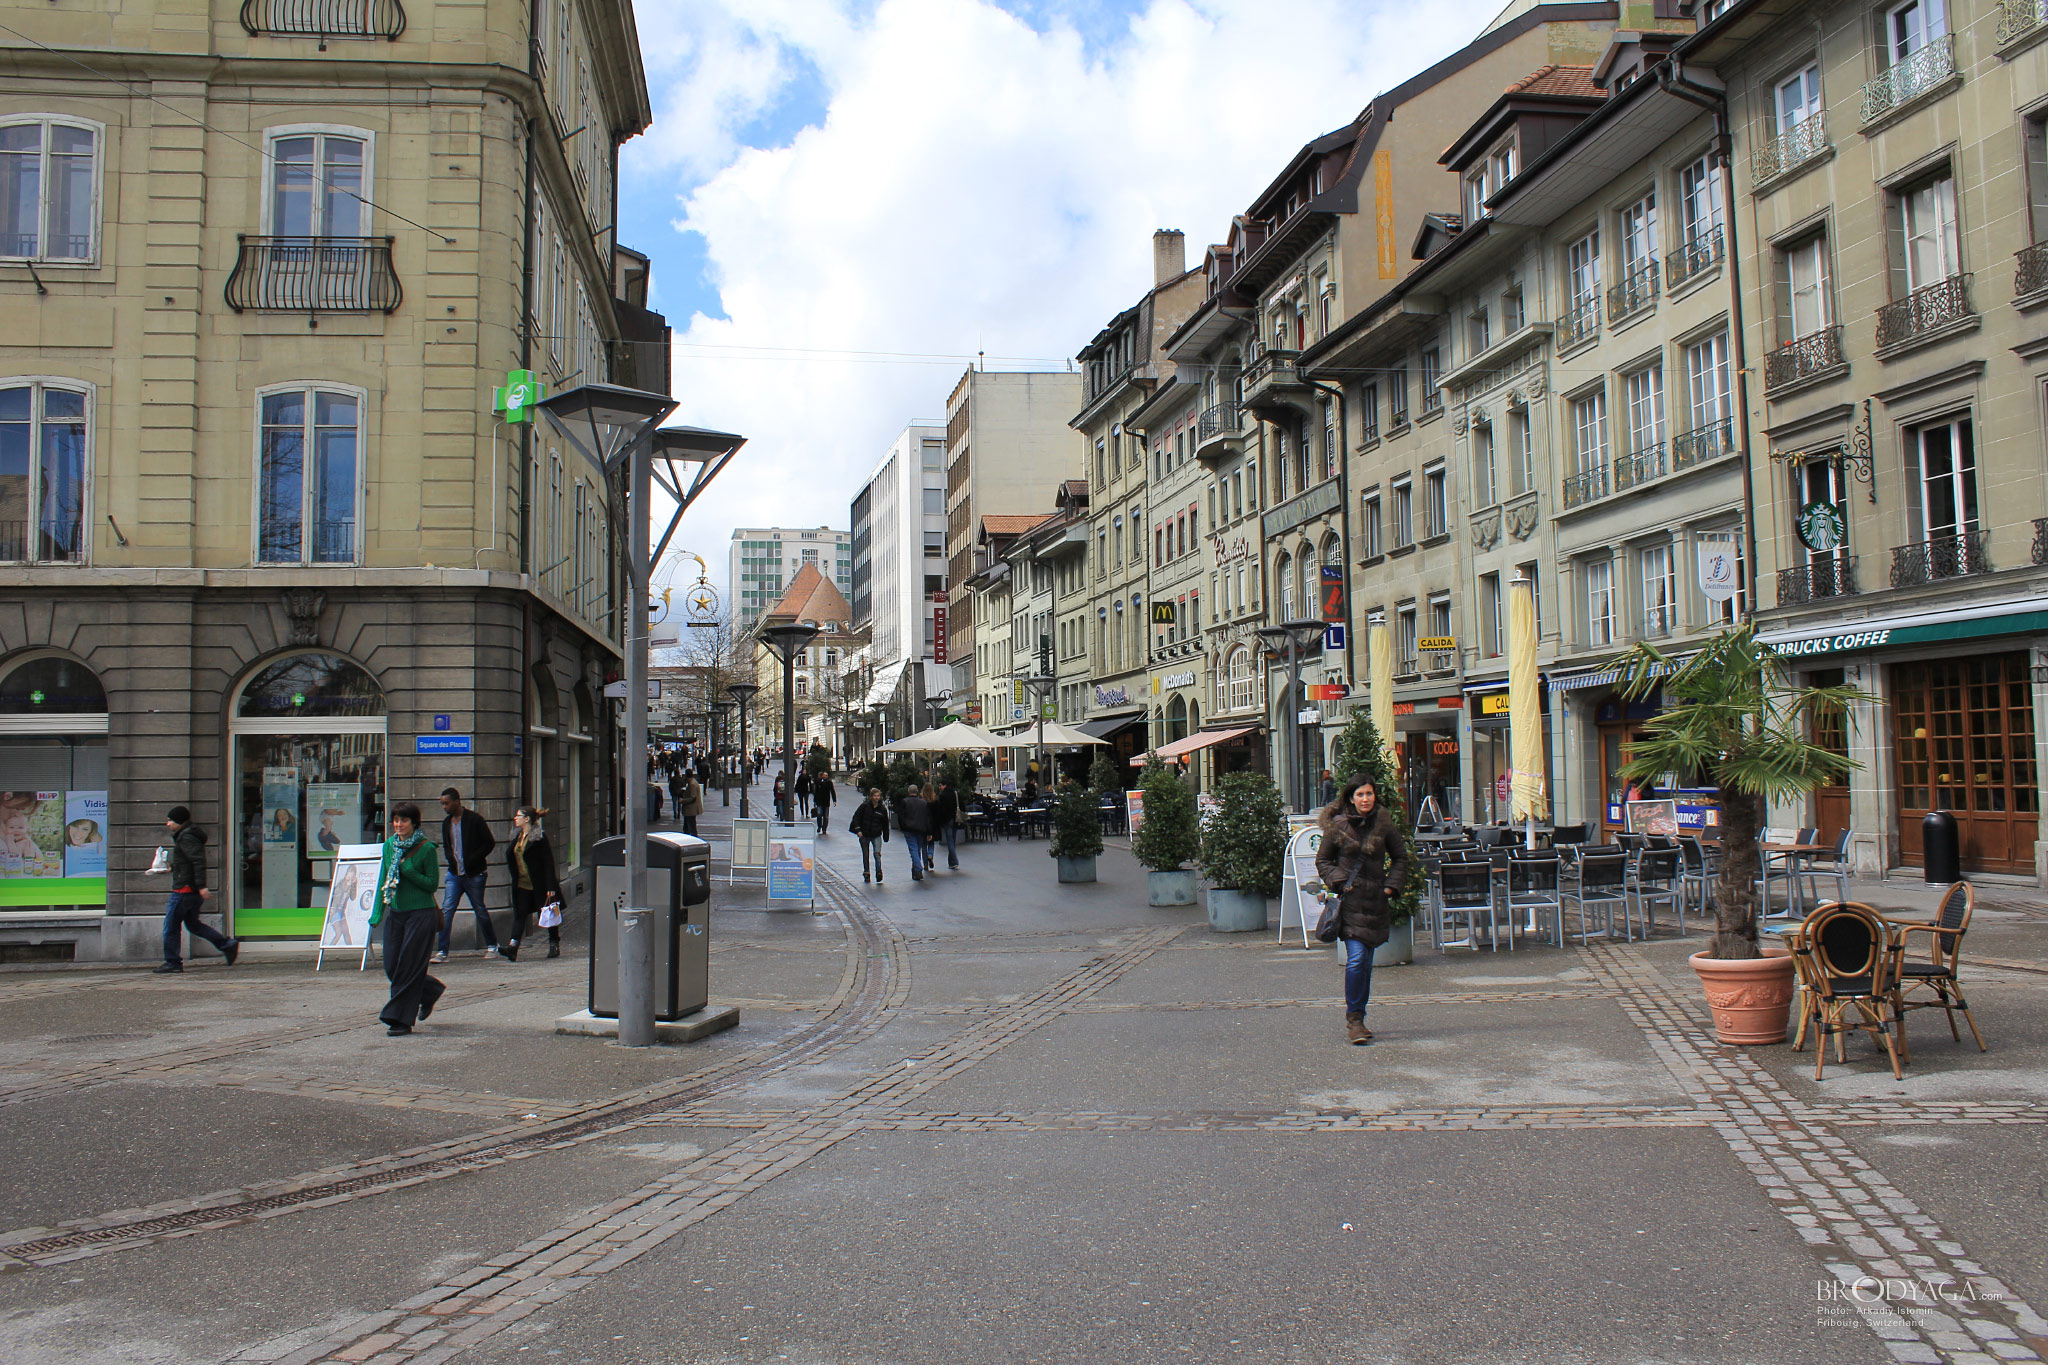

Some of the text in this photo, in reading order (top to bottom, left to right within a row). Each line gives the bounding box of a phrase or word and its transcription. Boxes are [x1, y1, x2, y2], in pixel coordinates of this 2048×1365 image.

[936, 610, 944, 662] talkwine
[1833, 630, 1891, 650] COFFEE
[1420, 639, 1453, 648] CALIDA
[1163, 671, 1195, 690] McDonald's
[1495, 697, 1509, 710] CAL
[419, 741, 438, 749] Square
[1433, 741, 1459, 755] KOOKA
[38, 792, 58, 800] HiPP
[1634, 804, 1664, 820] Pizza
